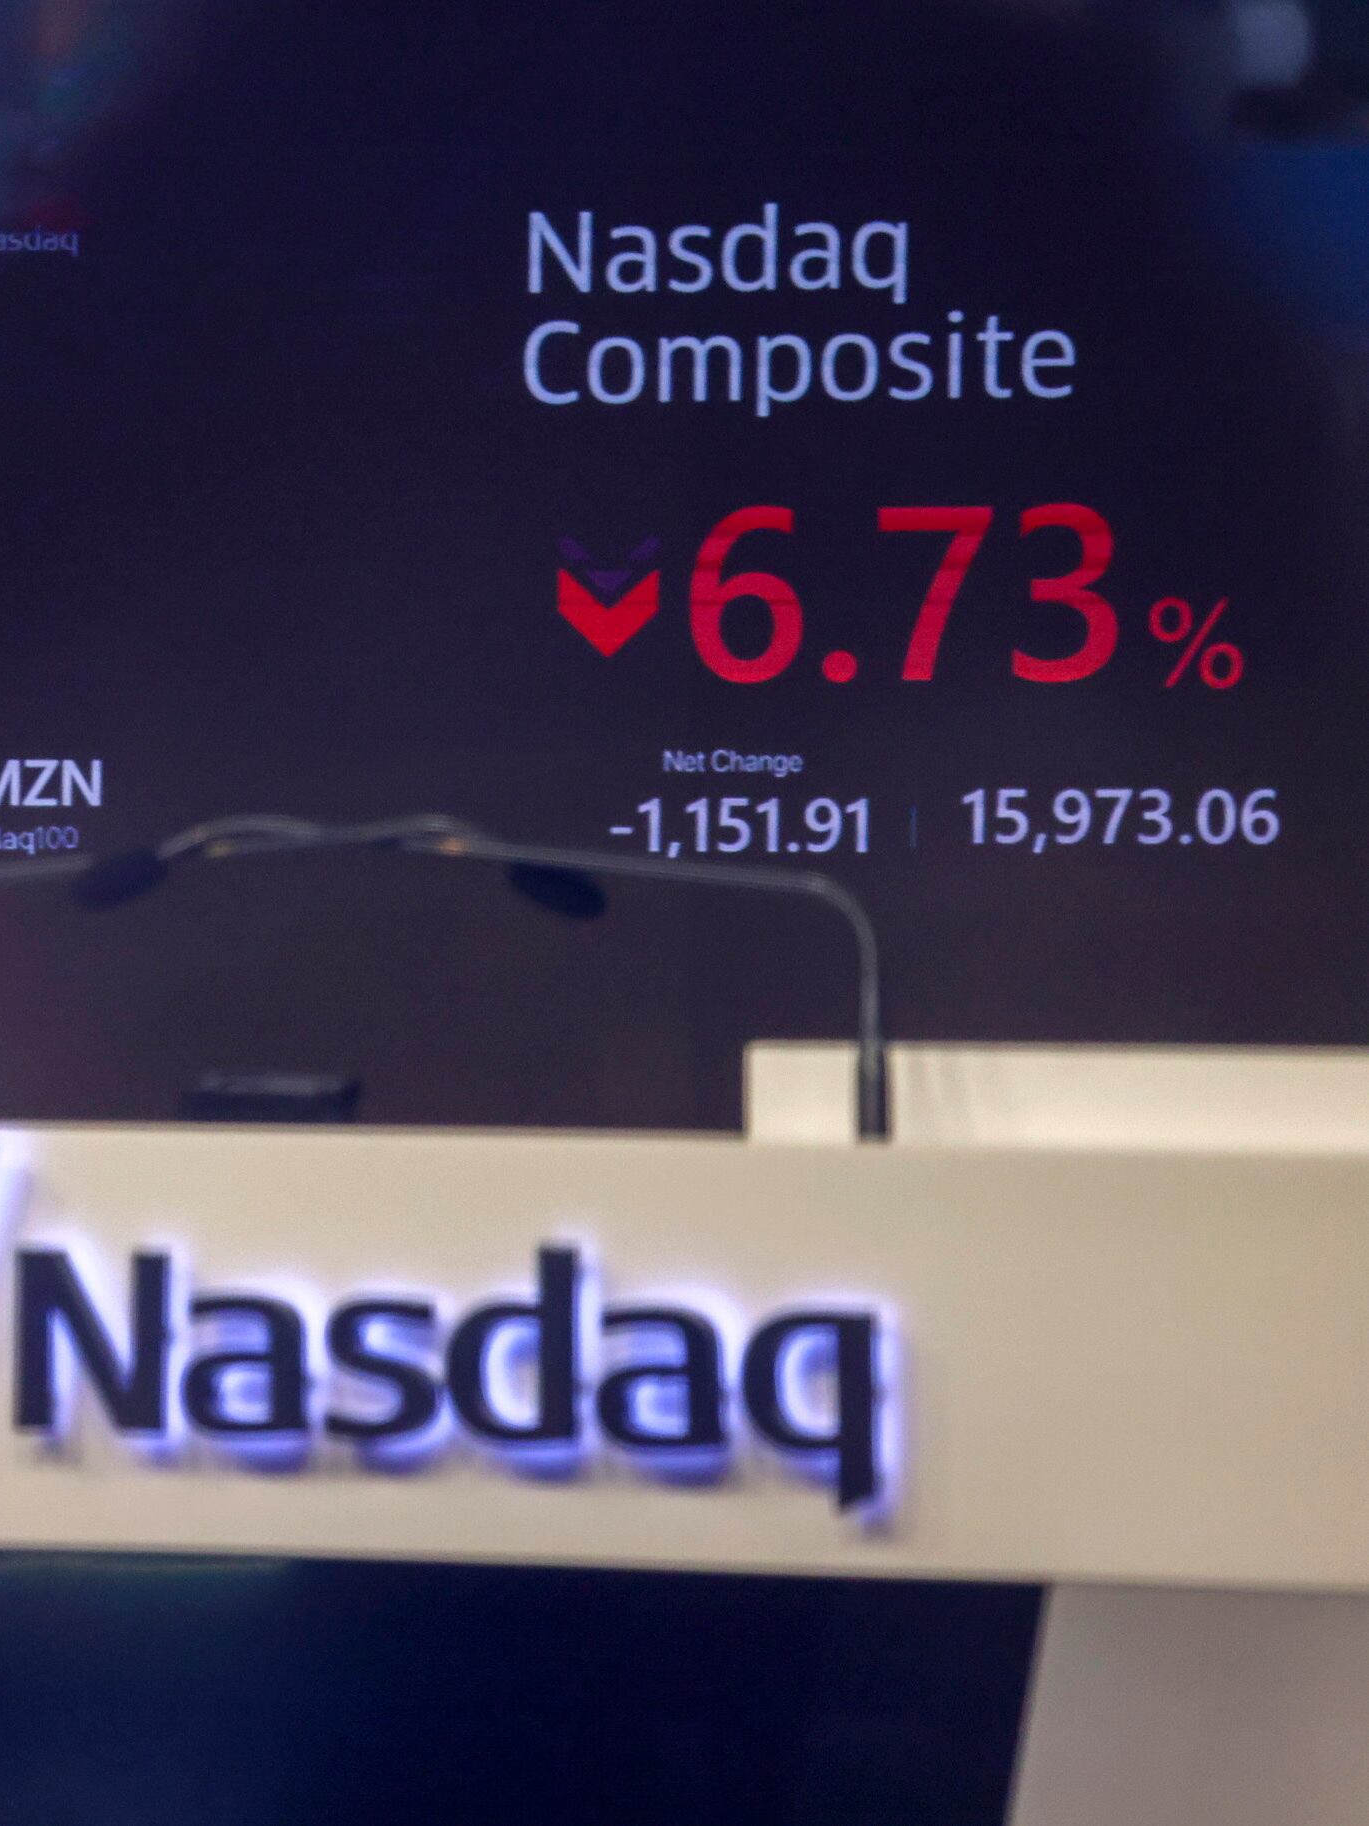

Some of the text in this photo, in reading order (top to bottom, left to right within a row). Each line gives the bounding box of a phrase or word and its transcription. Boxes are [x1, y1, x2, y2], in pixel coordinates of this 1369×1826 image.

[526, 202, 909, 304] Nasdaq
[522, 310, 1077, 418] Composite
[688, 502, 1244, 690] 6.73%
[662, 748, 804, 778] Net Change
[608, 796, 870, 858] -1,151.91
[961, 787, 1281, 854] 15,973.06
[14, 1242, 879, 1512] Nasdaq
